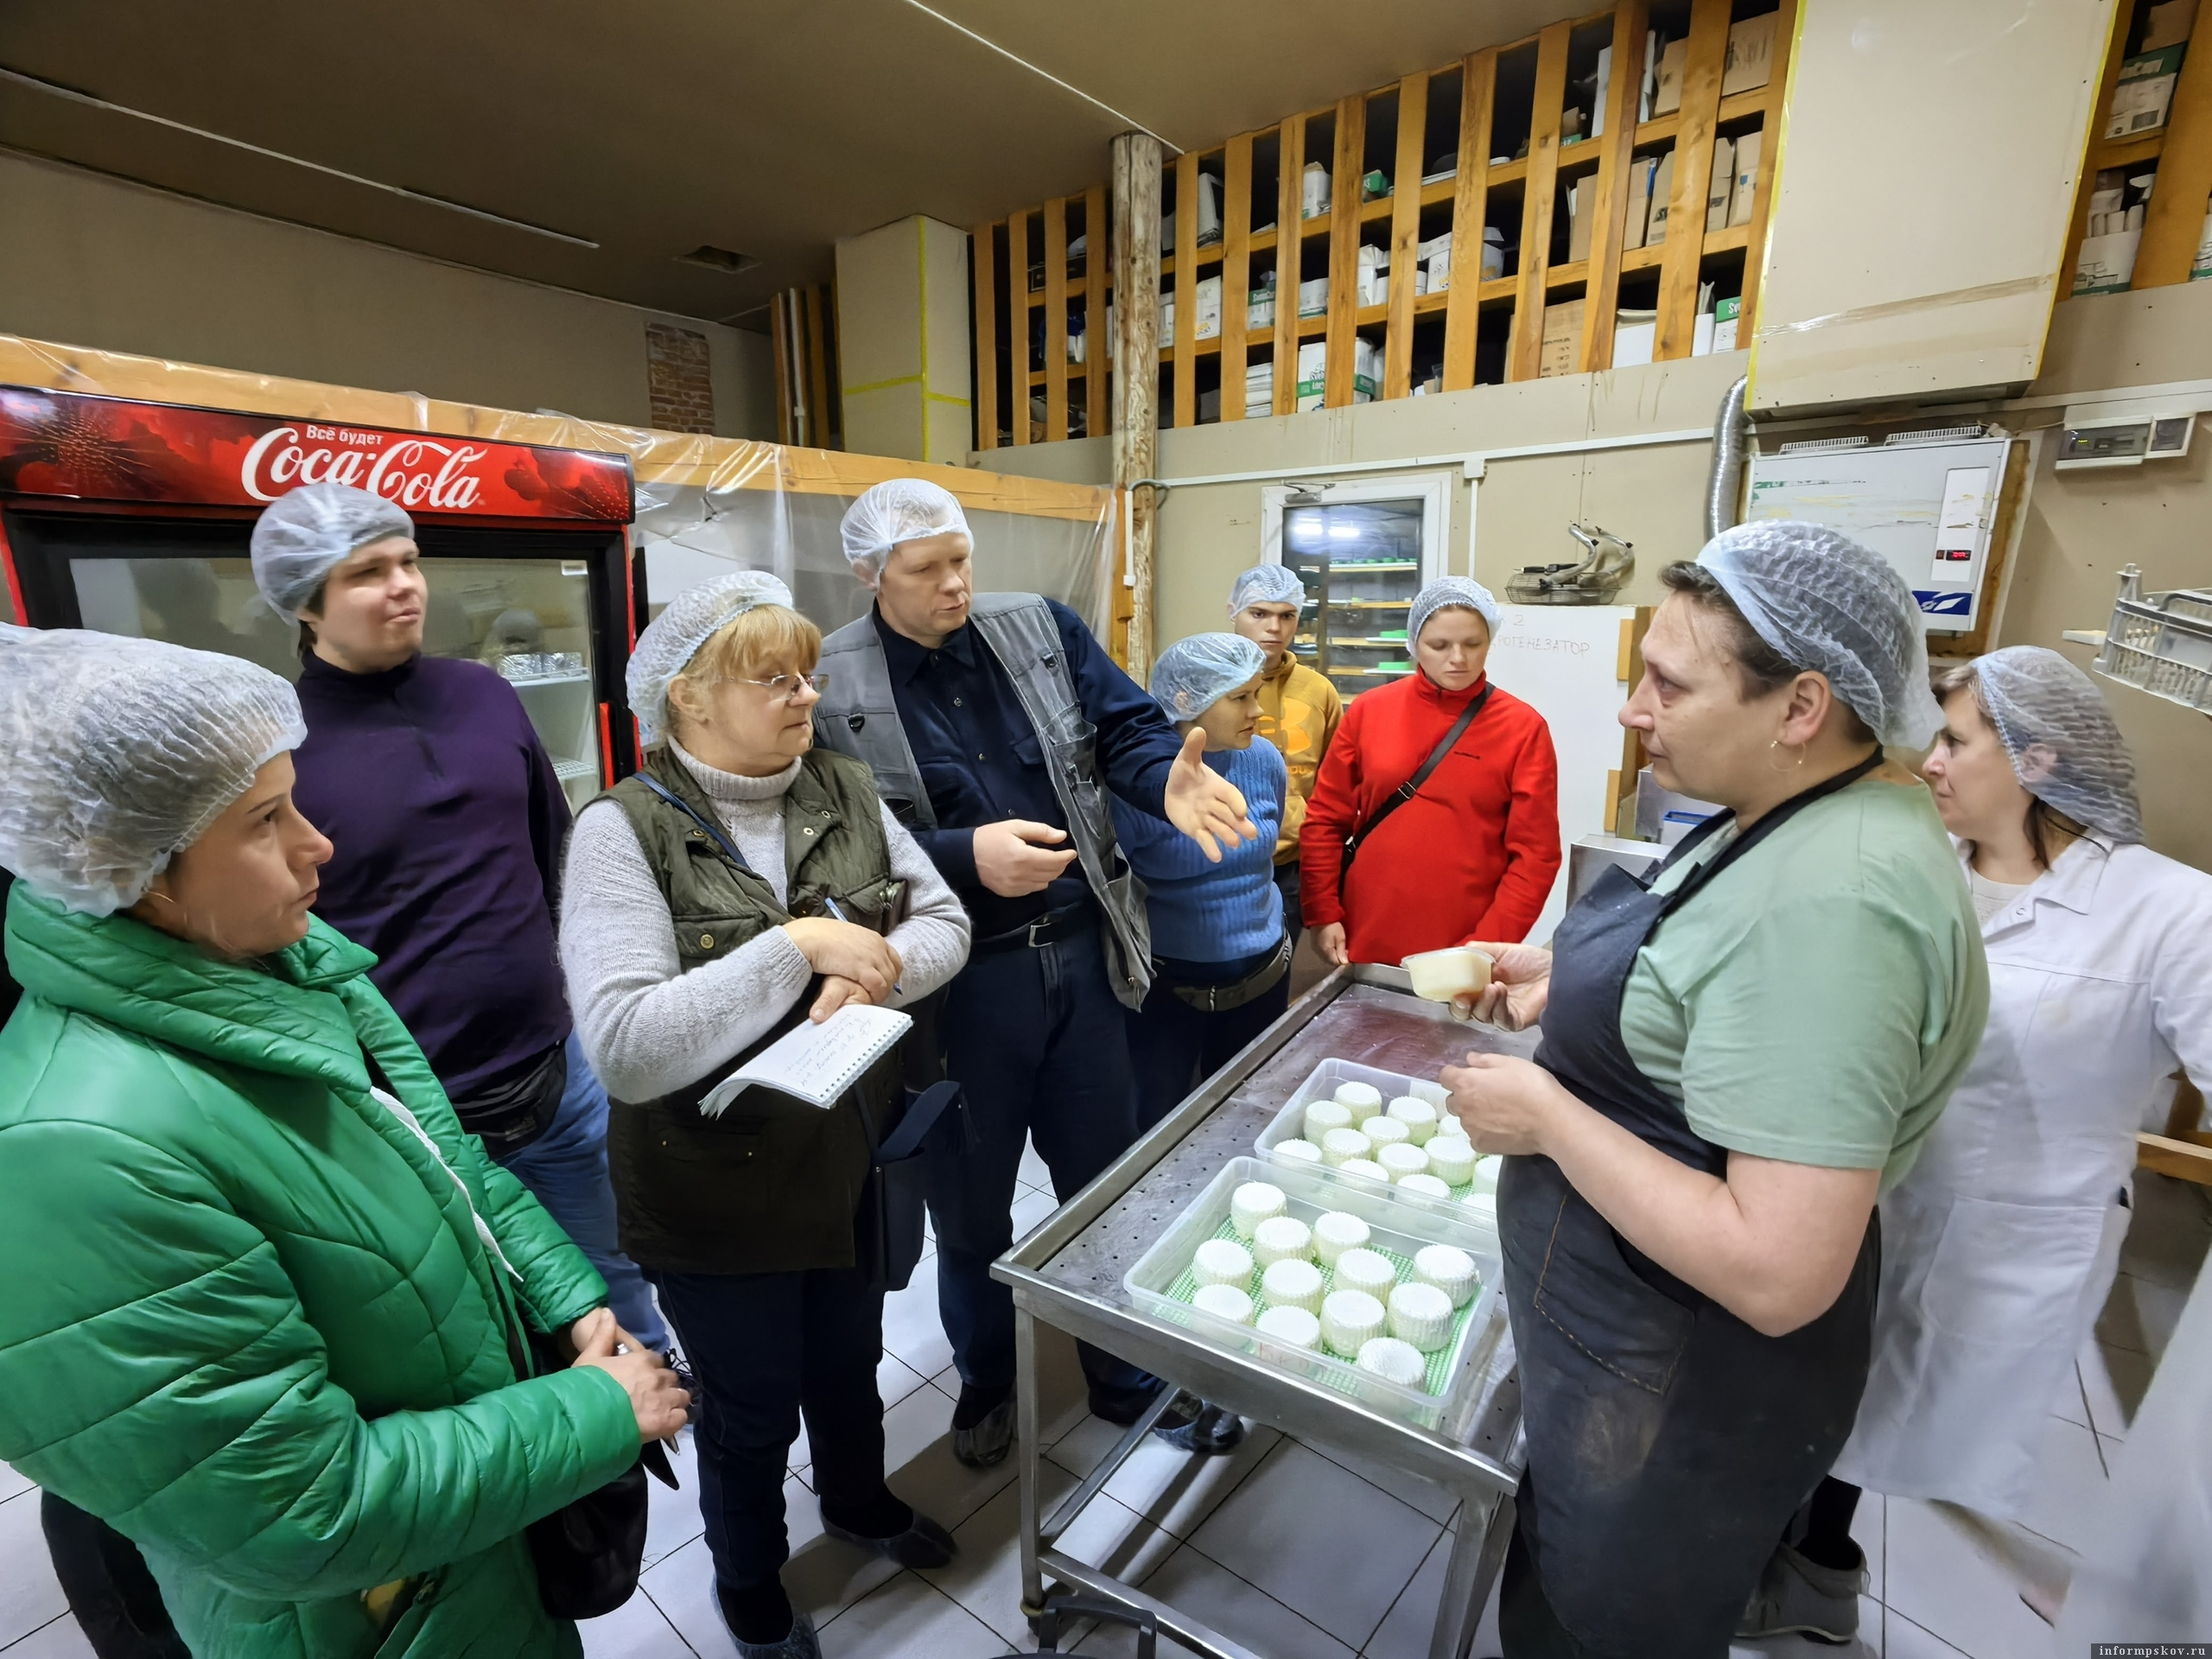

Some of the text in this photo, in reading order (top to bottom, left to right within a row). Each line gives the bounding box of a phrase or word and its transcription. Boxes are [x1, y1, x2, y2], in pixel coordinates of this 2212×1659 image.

[306, 424, 384, 446] Всё будет
[241, 427, 487, 509] Coca-Cola
